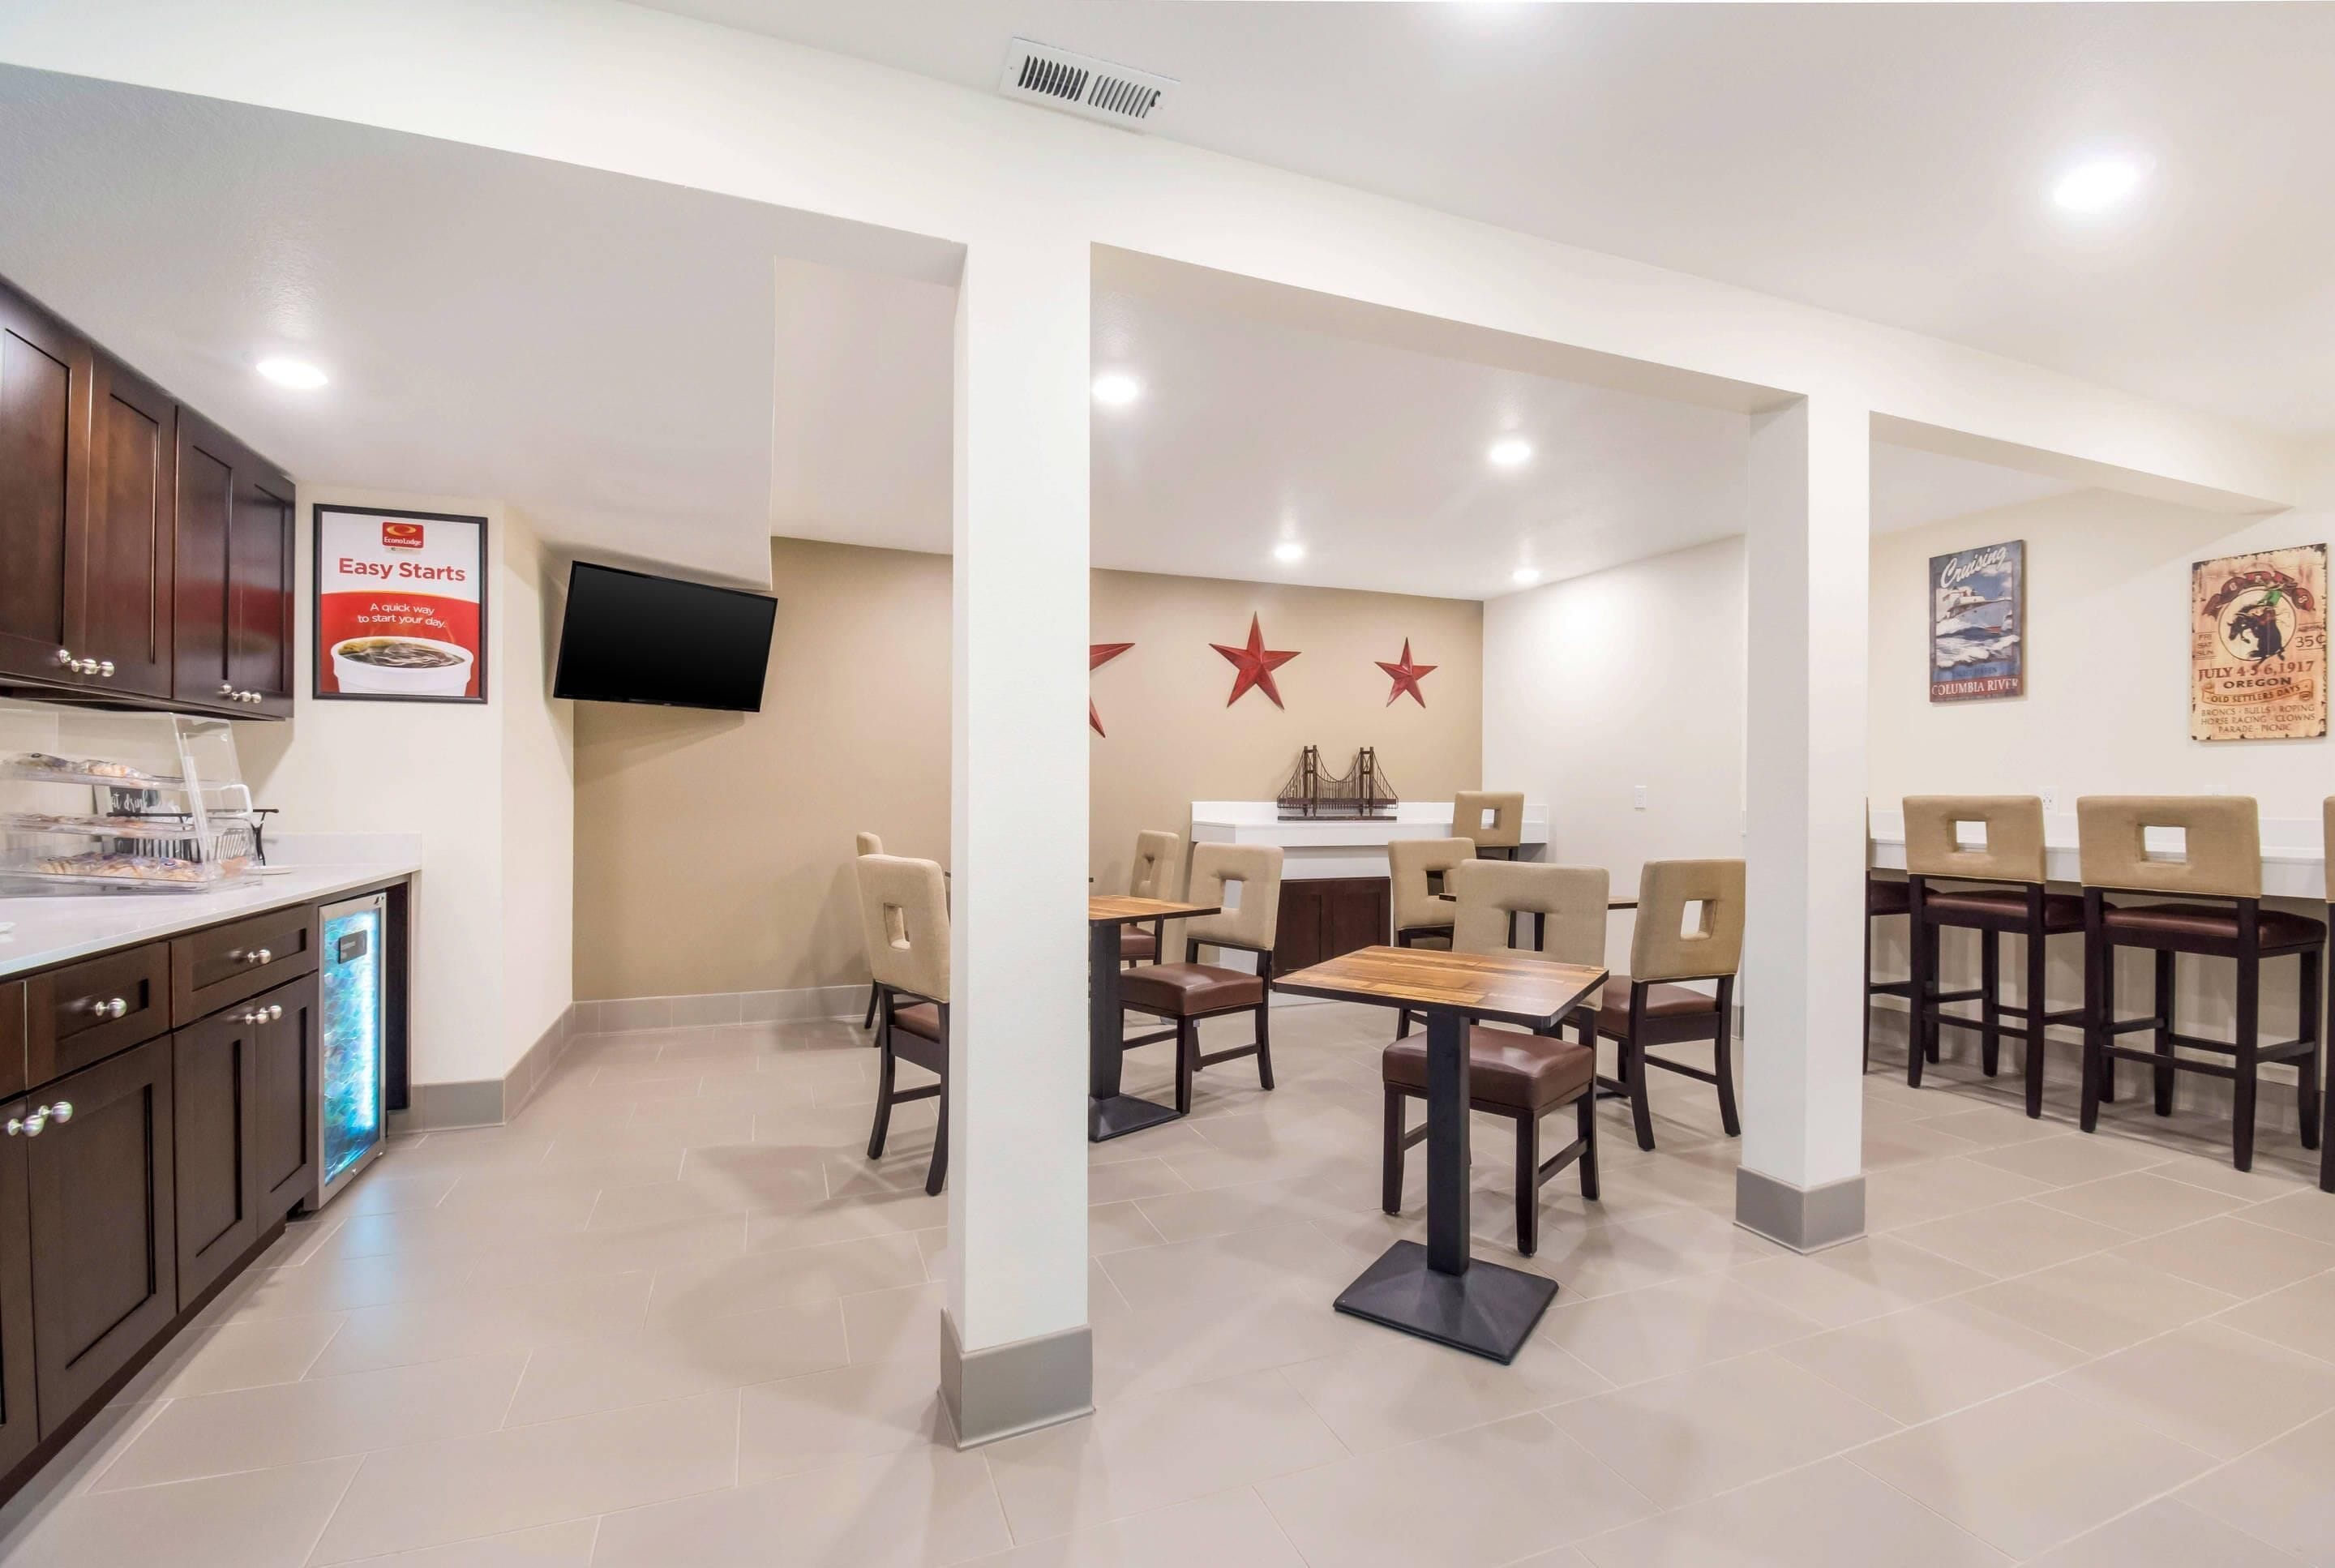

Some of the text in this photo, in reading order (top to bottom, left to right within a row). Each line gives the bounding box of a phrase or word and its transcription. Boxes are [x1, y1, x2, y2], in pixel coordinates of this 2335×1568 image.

[339, 557, 465, 581] Easy Starts
[1940, 546, 2007, 589] Cruising
[370, 603, 435, 616] A quick way
[358, 614, 447, 628] to start your day.
[2198, 666, 2234, 681] JULY
[1931, 678, 2019, 696] COLUMBIA RIVER
[2223, 677, 2292, 689] OREGON
[2233, 692, 2274, 703] SETTLERS
[2276, 684, 2301, 697] DAYS
[2279, 704, 2315, 713] ROPING
[2201, 713, 2316, 726] HORSE RACING CLOWNS
[2218, 723, 2291, 733] PARADE PICNIC
